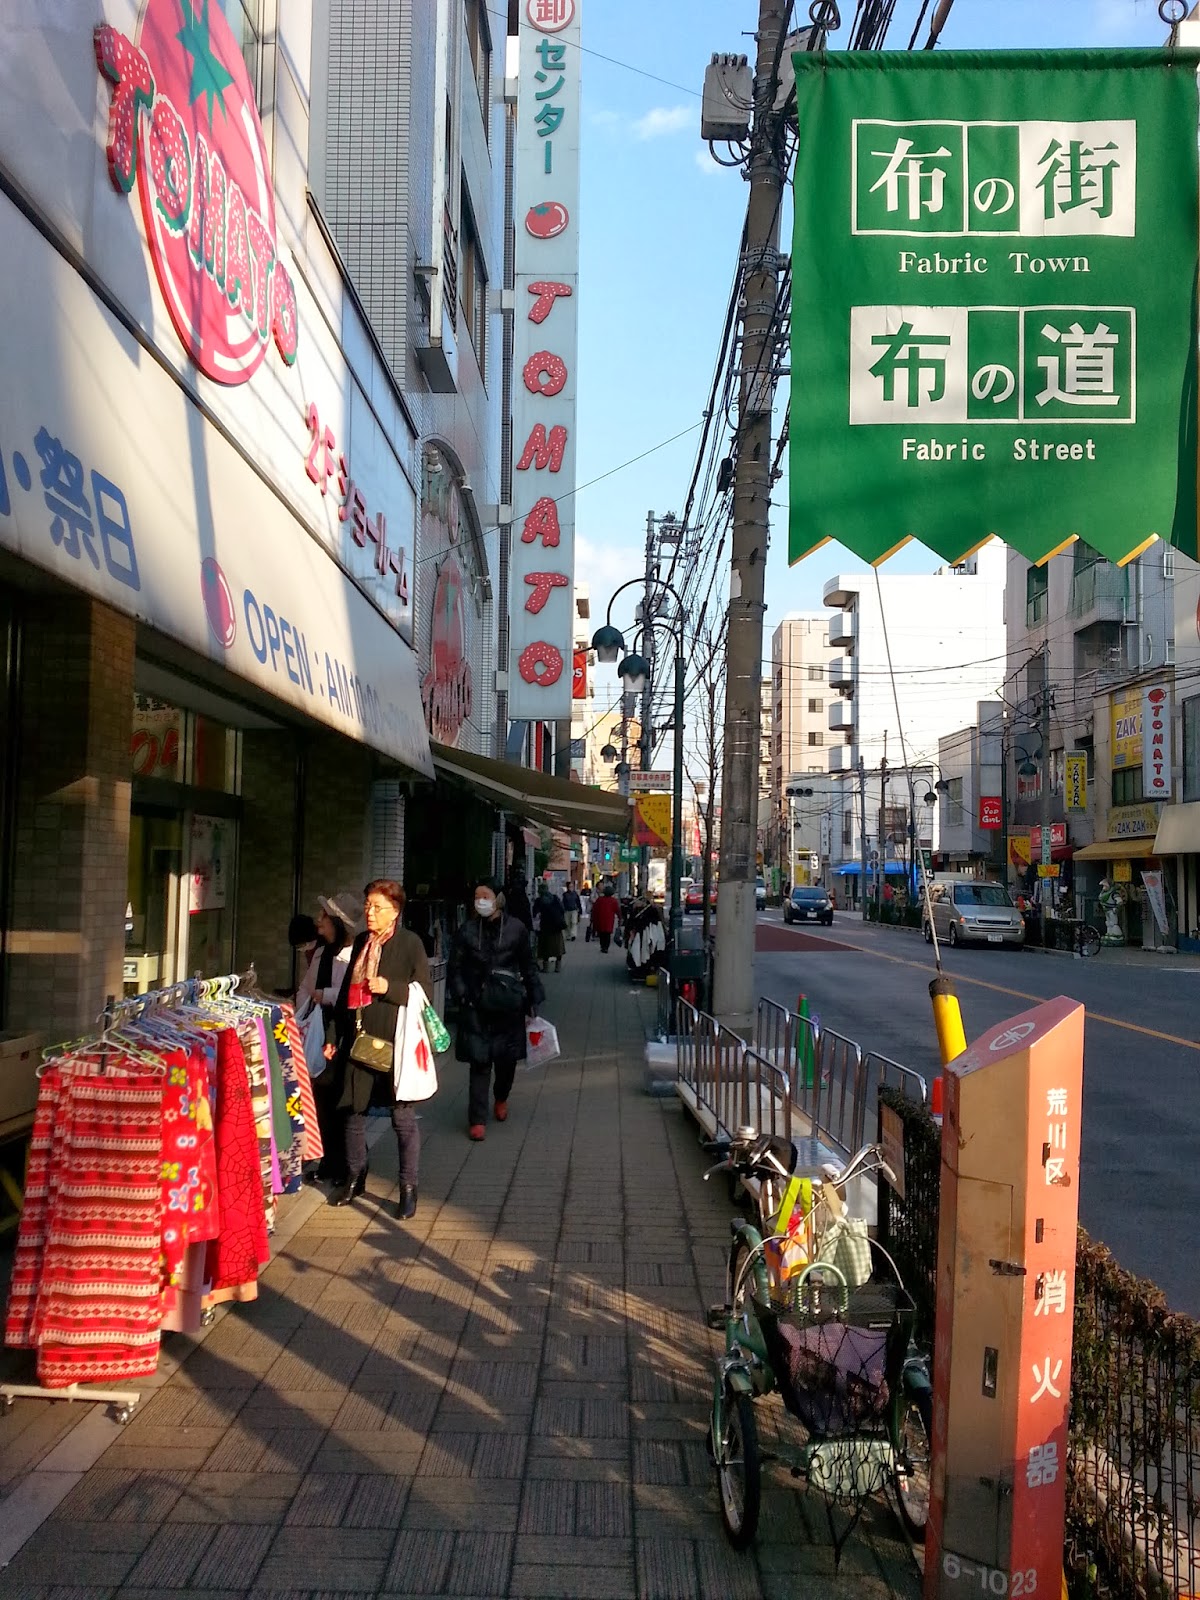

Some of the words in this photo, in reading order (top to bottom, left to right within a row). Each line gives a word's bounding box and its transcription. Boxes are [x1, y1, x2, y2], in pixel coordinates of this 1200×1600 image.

[93, 24, 299, 367] TOMATO
[869, 138, 1120, 221] 布の街
[899, 251, 989, 274] Fabric
[1008, 252, 1091, 273] Town
[869, 322, 1121, 408] 布の道
[517, 280, 572, 687] TOMATO
[902, 438, 986, 461] Fabric
[1013, 438, 1096, 461] Street
[1115, 716, 1137, 740] ZAK
[1151, 705, 1165, 788] TOMATO
[1117, 822, 1131, 834] ZAK
[1132, 819, 1146, 832] ZAK
[1045, 1088, 1068, 1186] 荒川区
[1025, 1269, 1067, 1489] 消火器
[942, 1552, 1008, 1596] 6-10
[1010, 1568, 1038, 1598] 23
